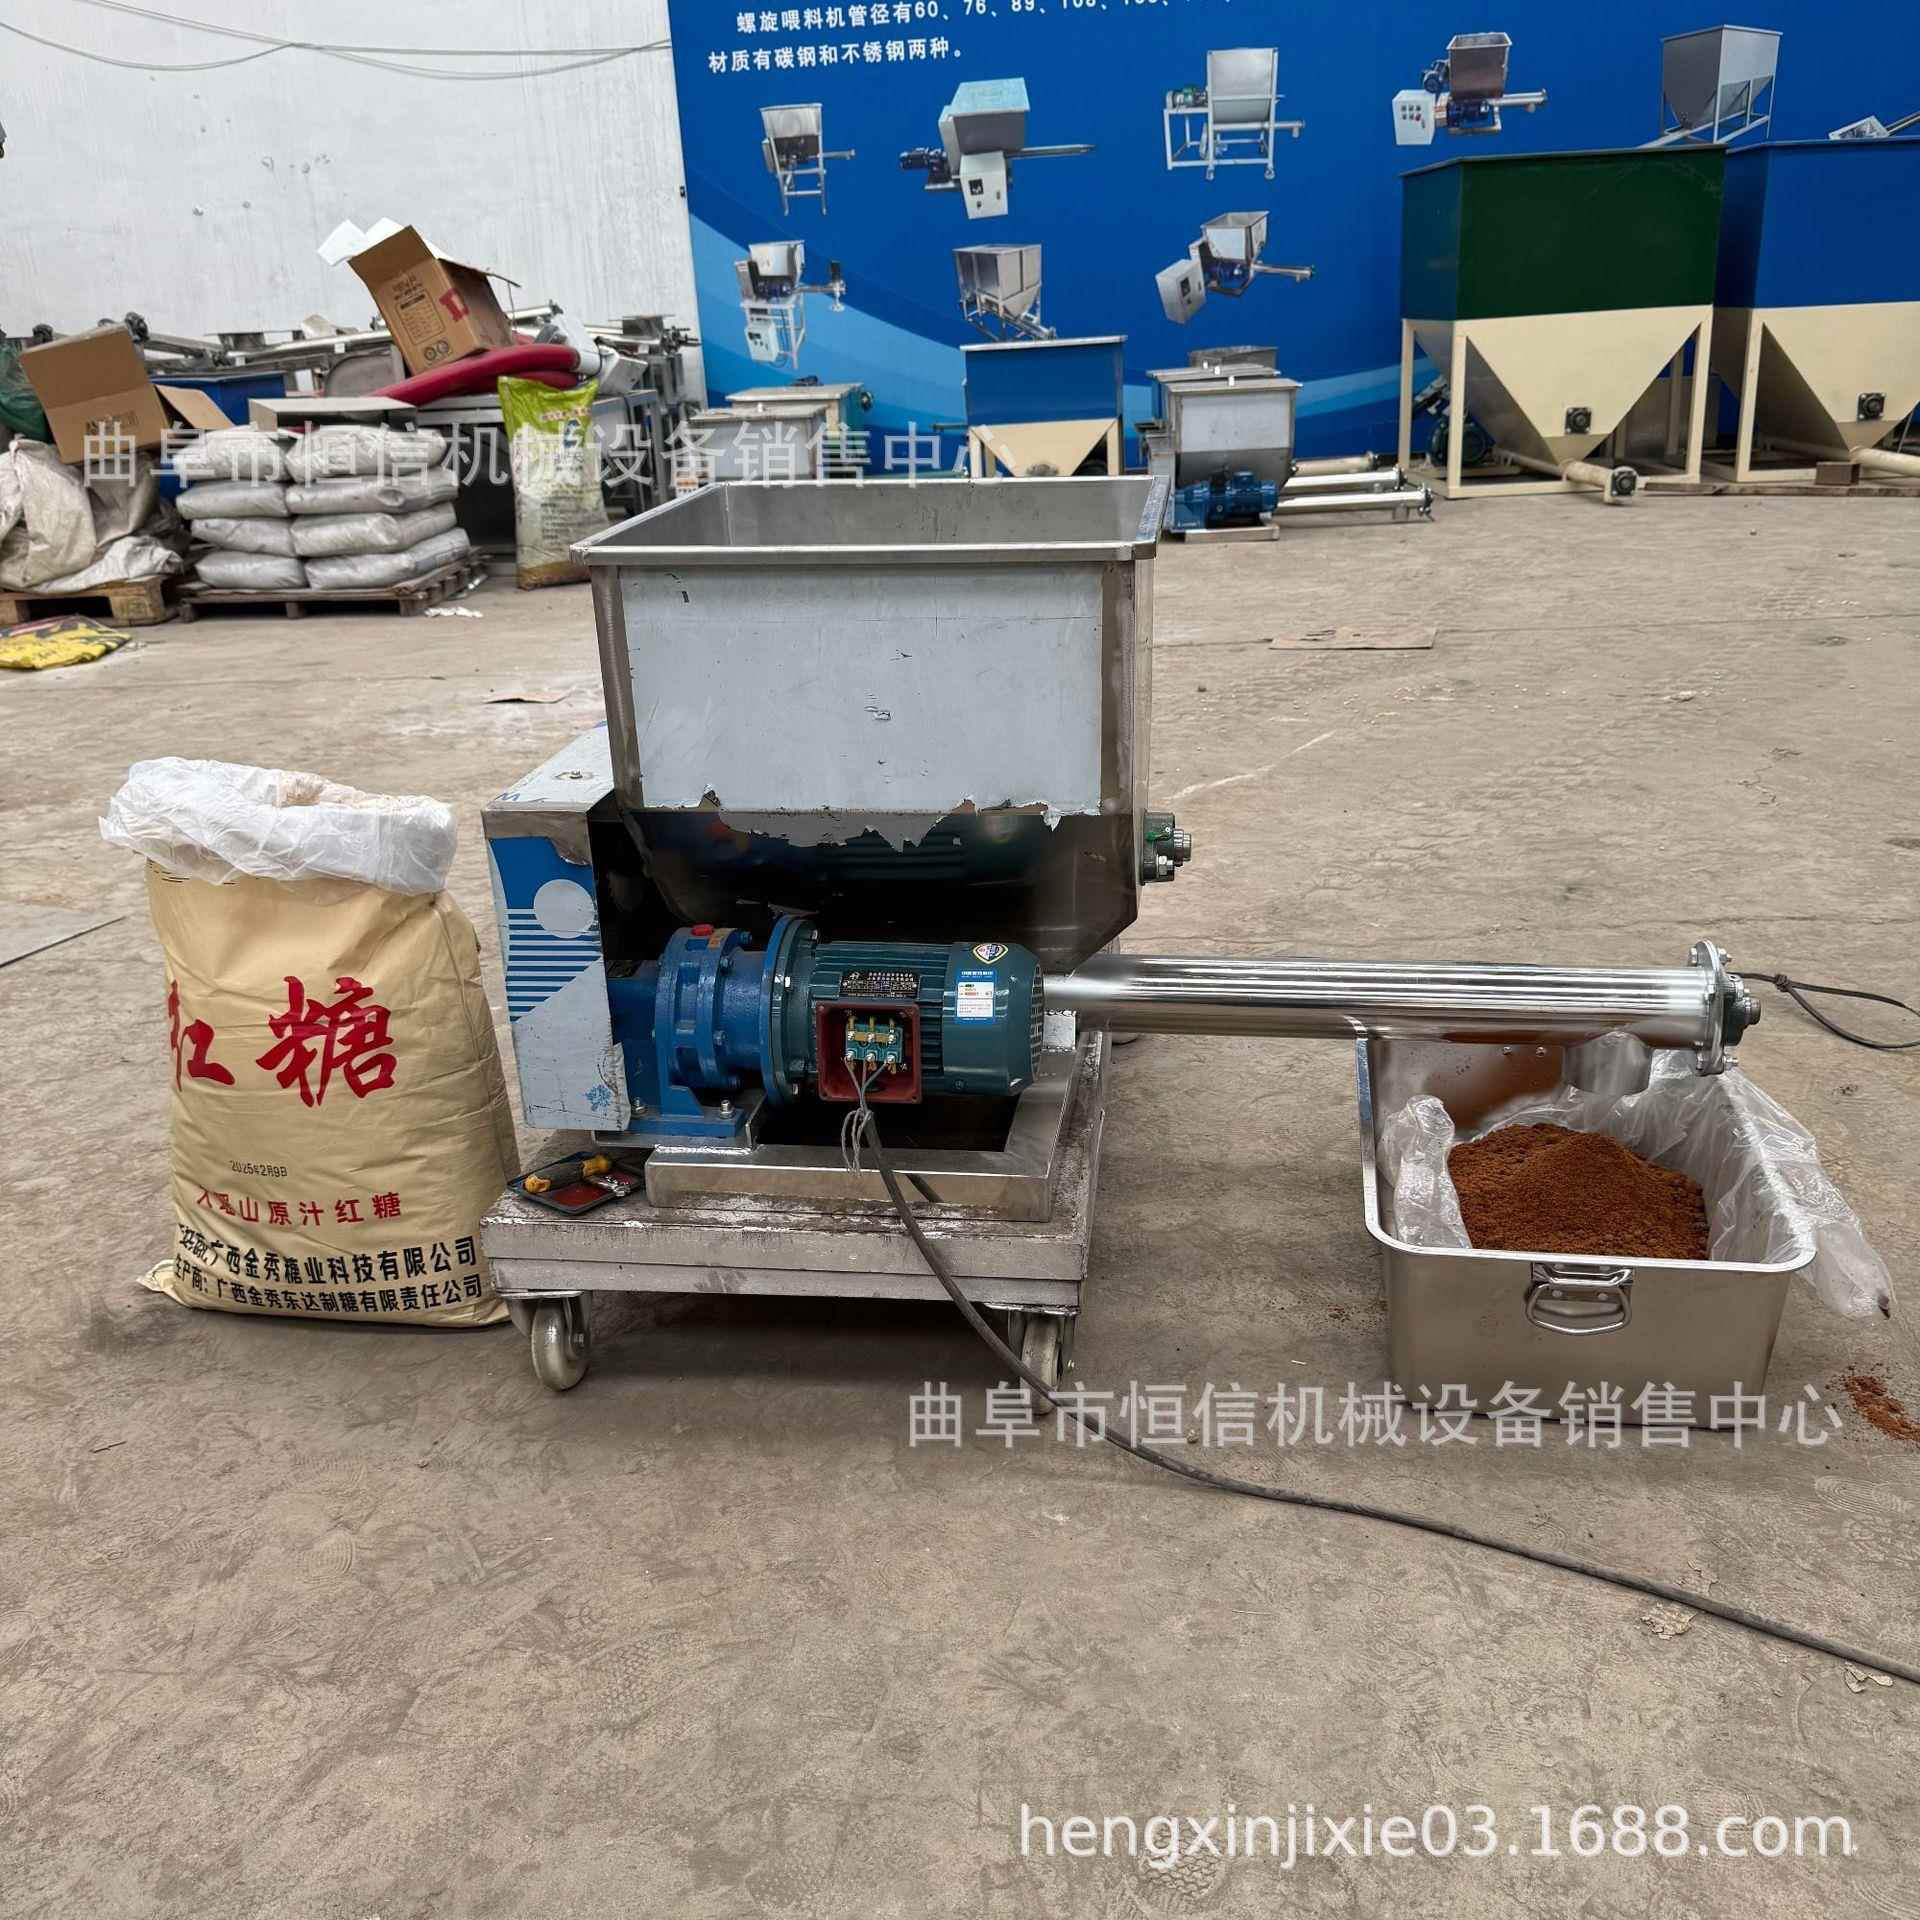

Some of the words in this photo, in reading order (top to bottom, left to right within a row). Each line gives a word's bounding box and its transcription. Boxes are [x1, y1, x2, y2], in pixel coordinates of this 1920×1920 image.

[708, 36, 962, 74] 材质有碳钢和不锈钢两种。
